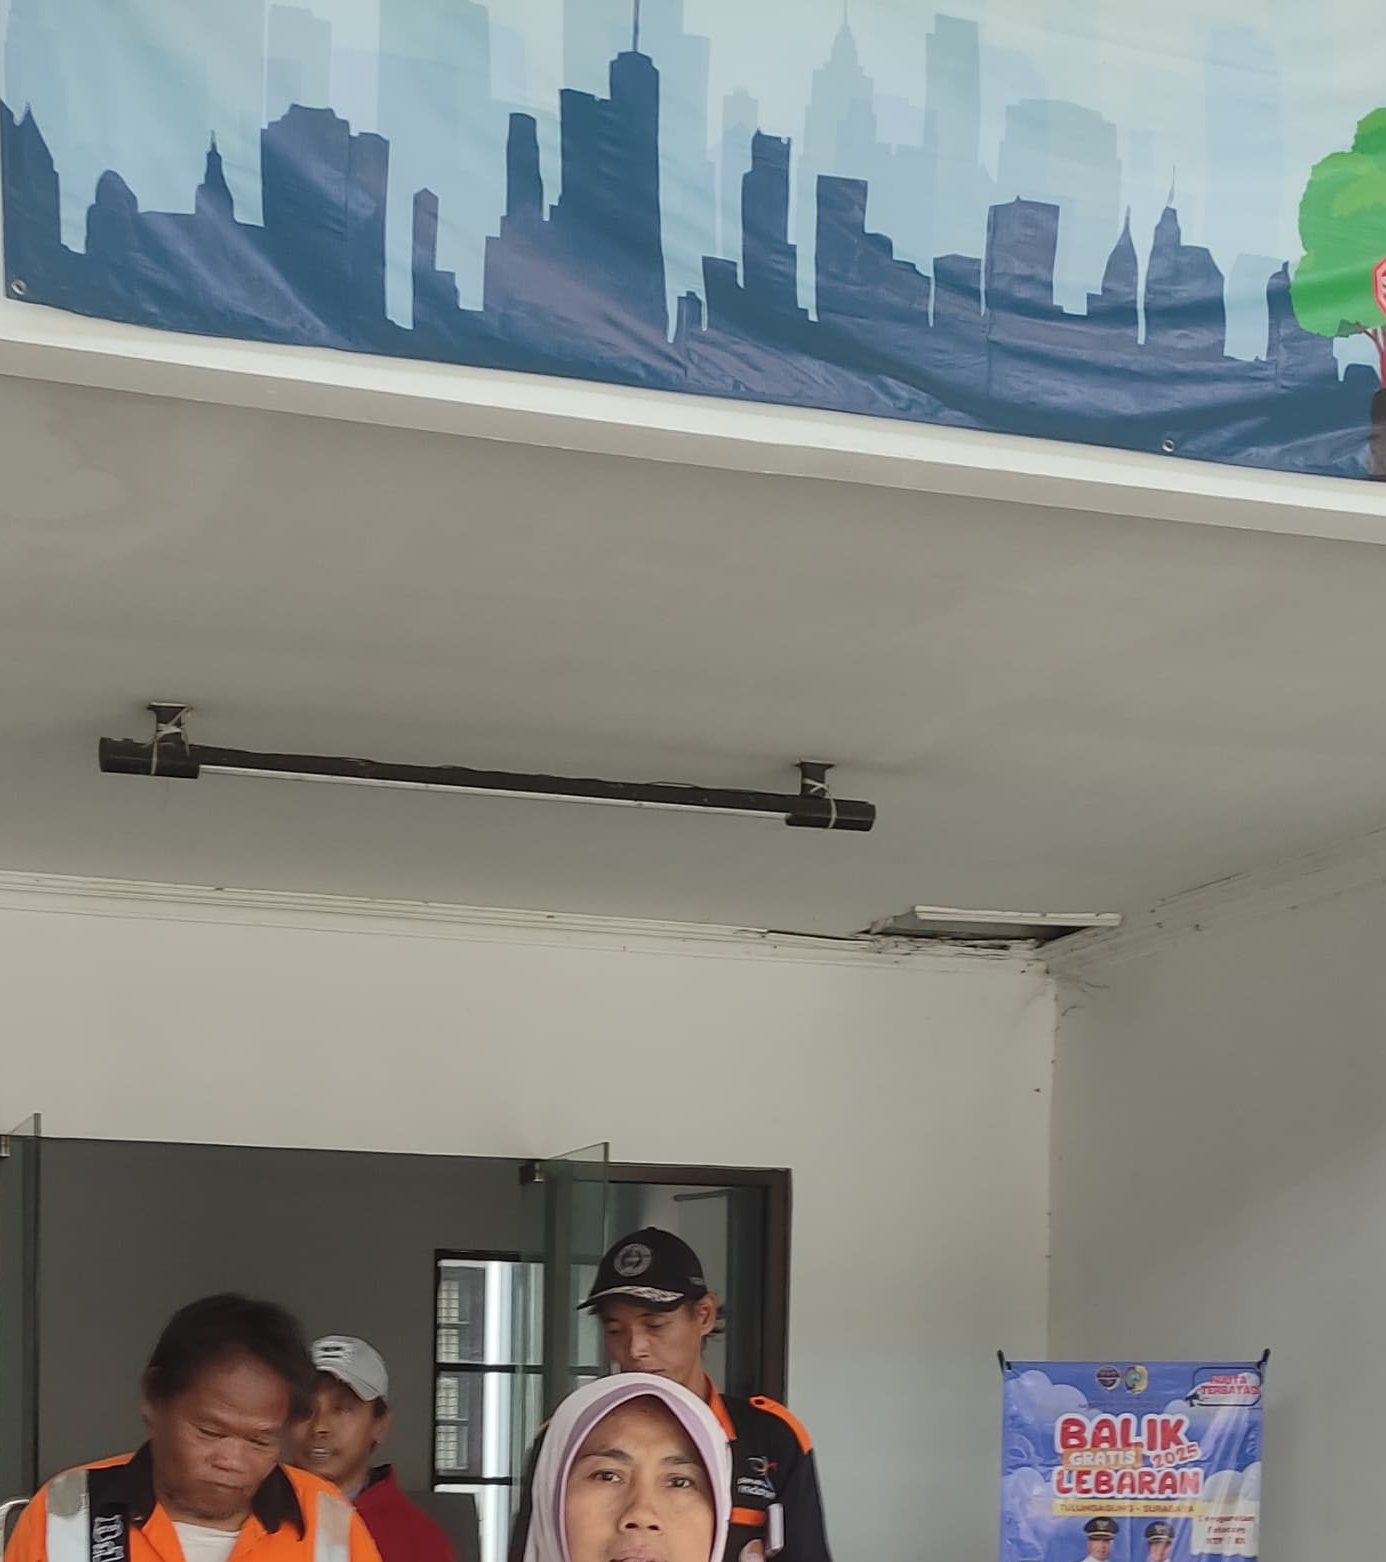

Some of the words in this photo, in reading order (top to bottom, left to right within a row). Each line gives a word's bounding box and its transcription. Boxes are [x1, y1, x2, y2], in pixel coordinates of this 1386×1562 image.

[1059, 1416, 1186, 1452] BALIK
[1068, 1450, 1137, 1467] GRATIS
[1153, 1443, 1199, 1469] 2025
[1055, 1470, 1201, 1496] LEBARAN
